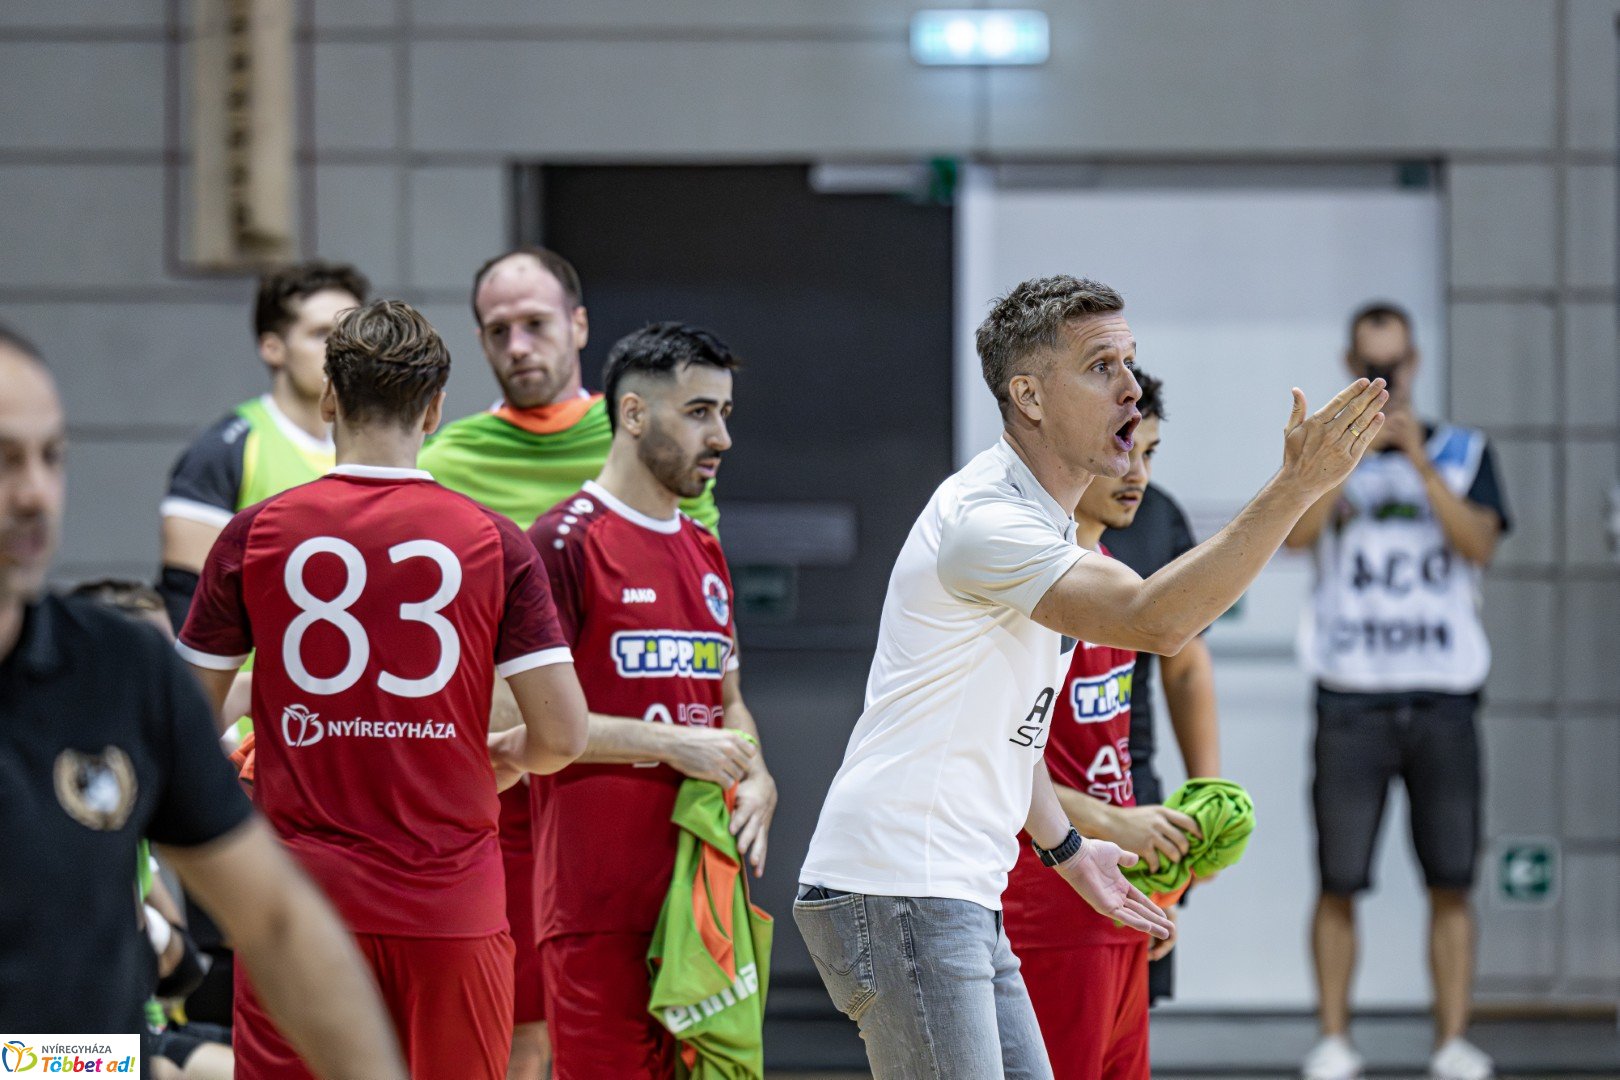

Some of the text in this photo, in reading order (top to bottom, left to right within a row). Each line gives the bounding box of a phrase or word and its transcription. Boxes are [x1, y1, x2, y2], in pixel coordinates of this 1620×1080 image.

[622, 587, 657, 604] JAKO
[282, 535, 463, 698] 83
[327, 716, 457, 740] NYÍREGYHÁZA
